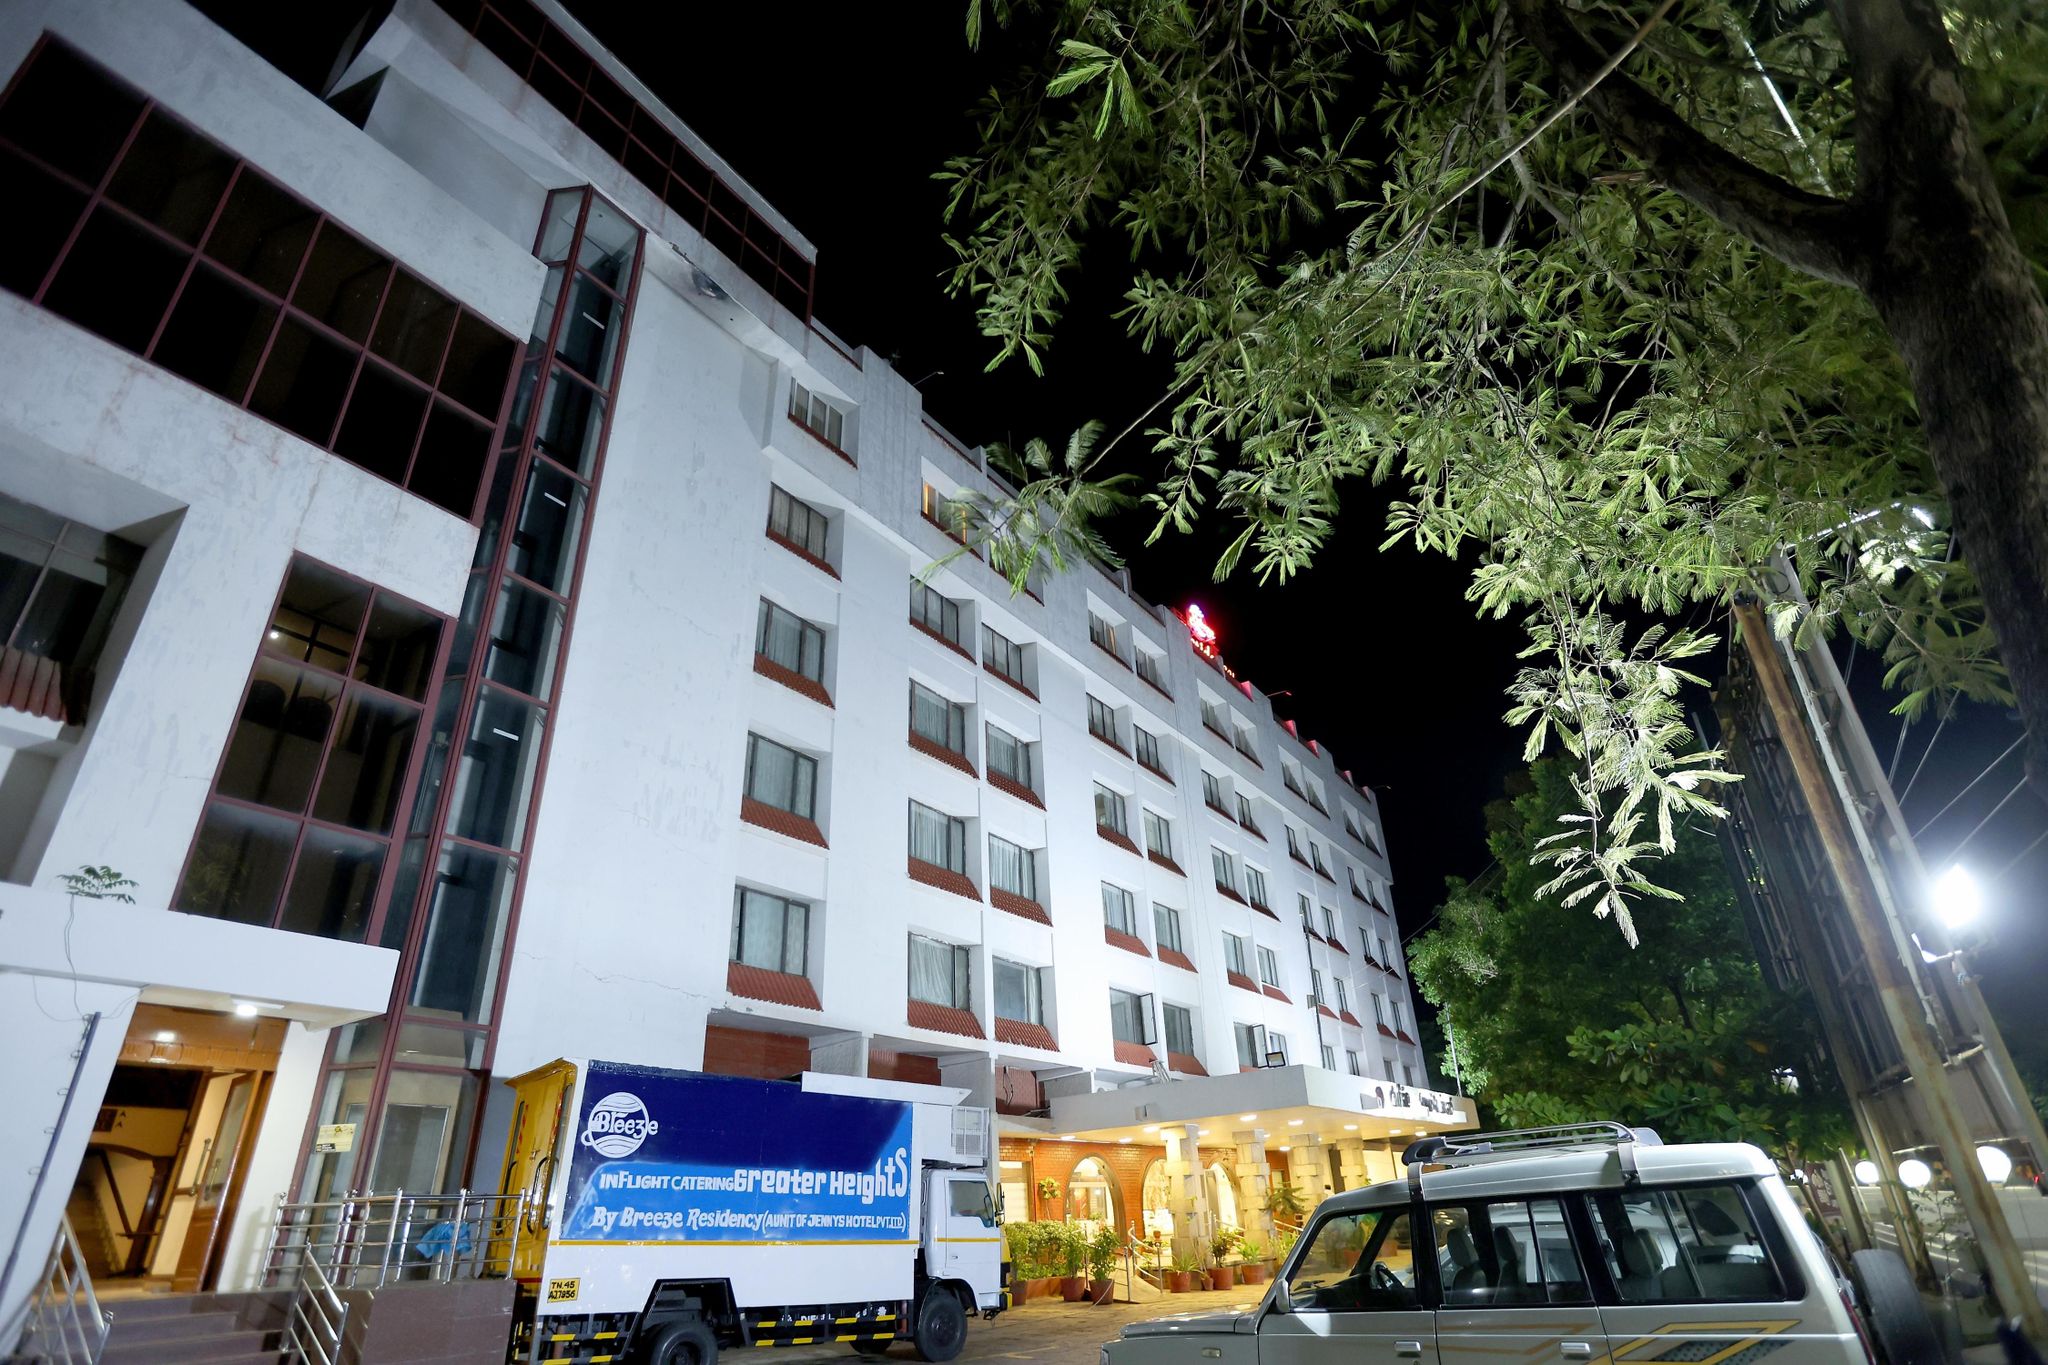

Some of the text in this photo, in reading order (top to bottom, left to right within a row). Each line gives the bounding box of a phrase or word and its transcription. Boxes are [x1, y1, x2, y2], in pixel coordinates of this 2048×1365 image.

[591, 1111, 659, 1139] Breeze
[600, 1170, 671, 1190] INFLIGHT
[671, 1175, 735, 1191] CATERING
[734, 1169, 827, 1195] Greater
[590, 1206, 619, 1232] By
[619, 1206, 684, 1229] Breeze
[686, 1208, 764, 1232] Residency
[796, 1214, 807, 1228] OF
[807, 1214, 846, 1229] JENNYS
[845, 1215, 876, 1229] HOTEL
